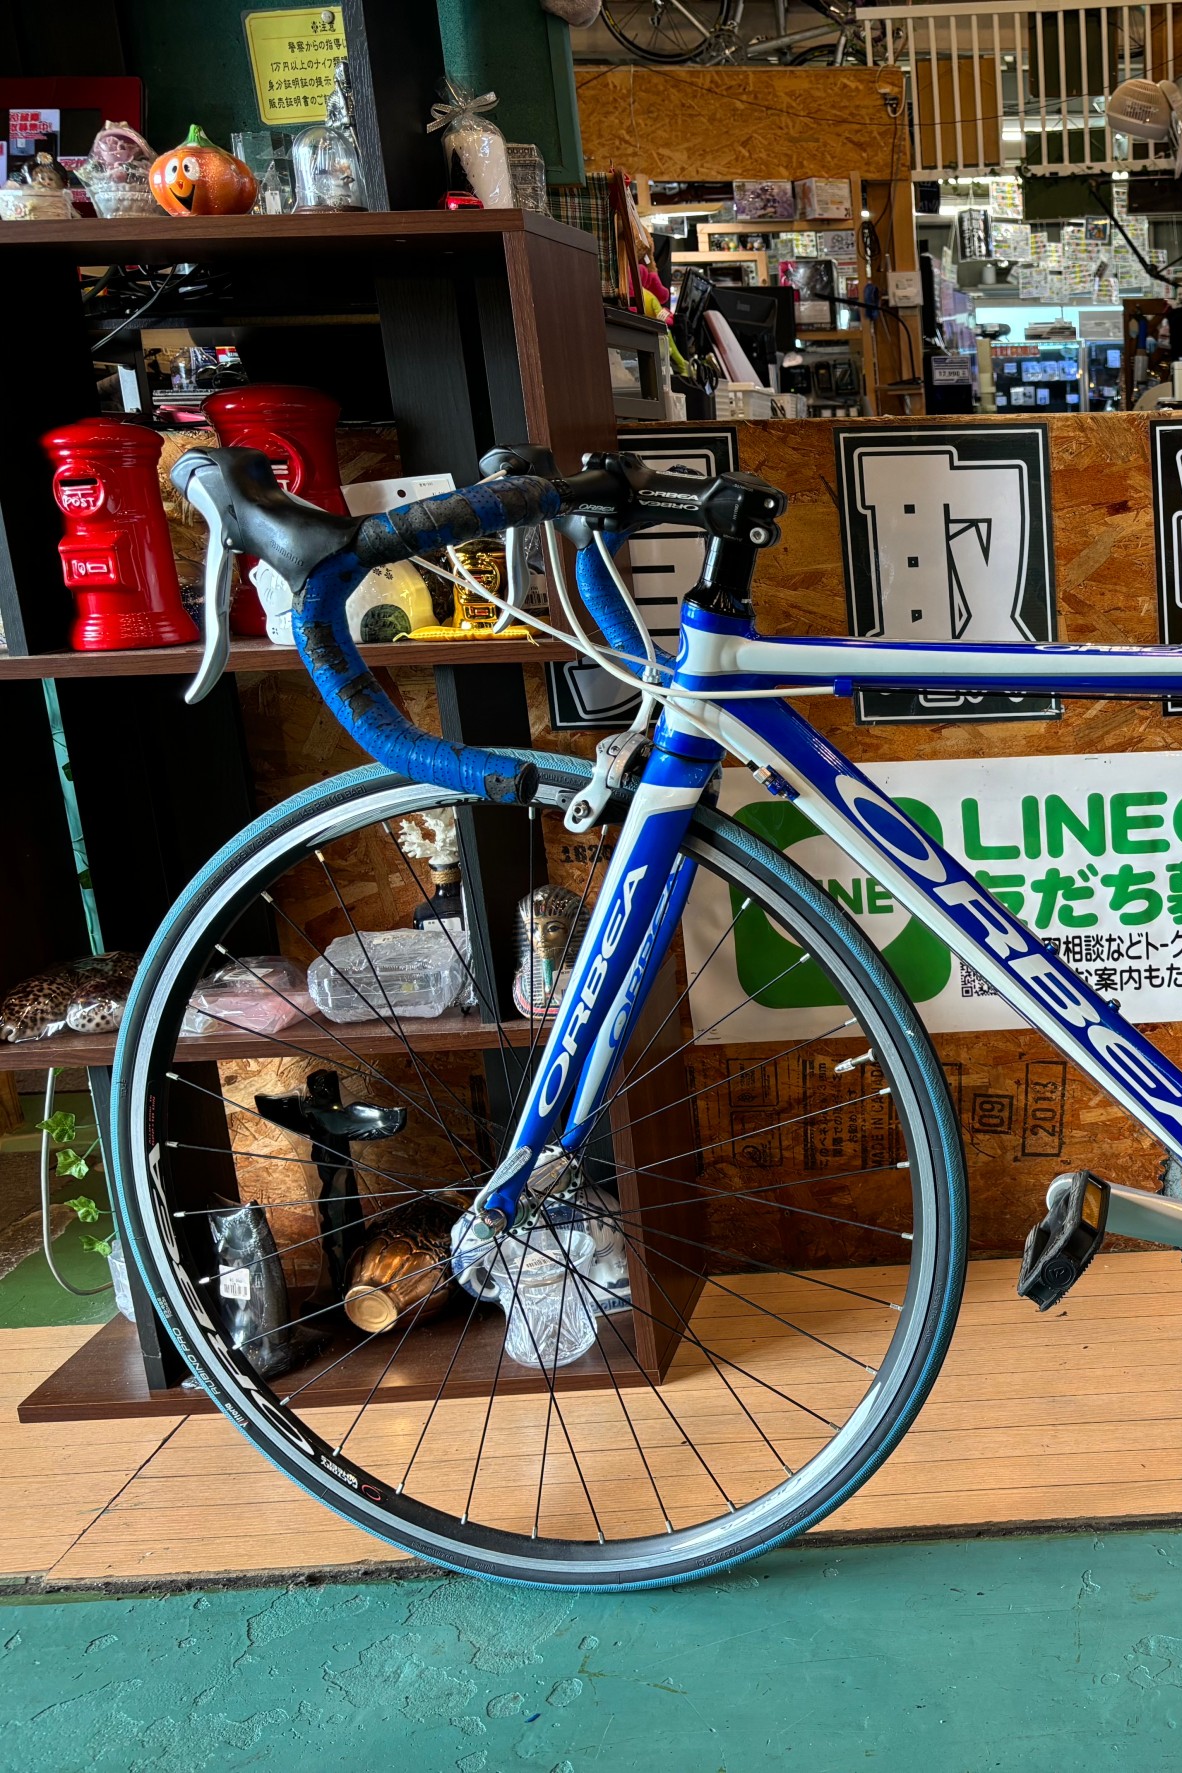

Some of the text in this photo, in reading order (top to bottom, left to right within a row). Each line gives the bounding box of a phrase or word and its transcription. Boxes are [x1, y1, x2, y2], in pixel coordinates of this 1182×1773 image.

[578, 502, 615, 514] ORBEA
[638, 489, 700, 501] ORBEA
[538, 864, 649, 1118] ORBEA
[871, 1117, 884, 1130] IN
[871, 1134, 885, 1169] MADE
[149, 1142, 315, 1456] ORBEA
[172, 1326, 221, 1396] RUBINO PRO
[224, 1401, 248, 1429] Vittoria
